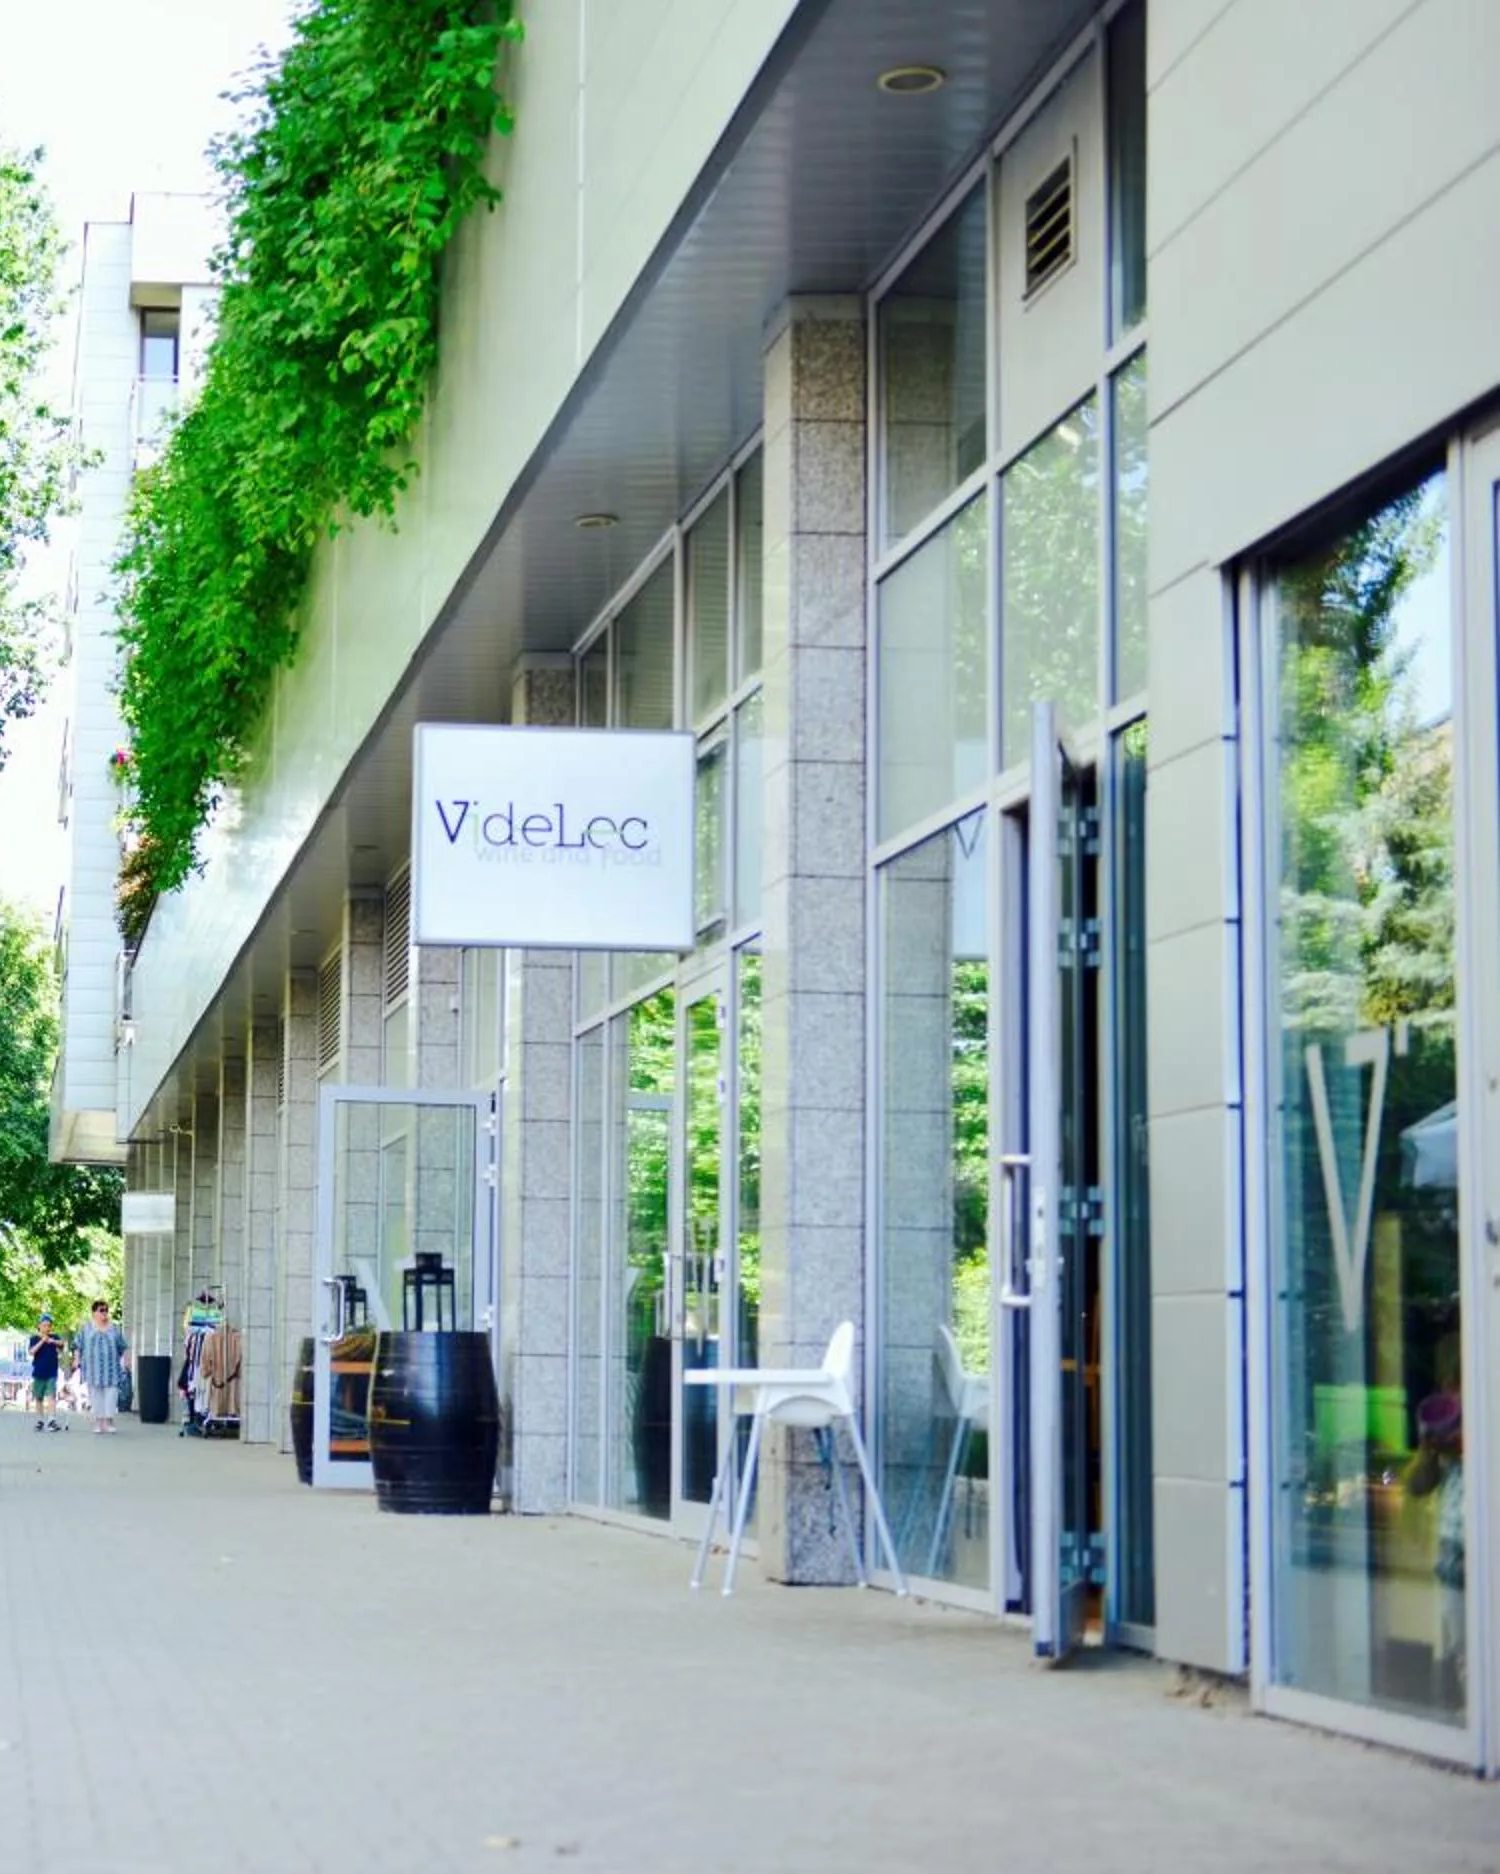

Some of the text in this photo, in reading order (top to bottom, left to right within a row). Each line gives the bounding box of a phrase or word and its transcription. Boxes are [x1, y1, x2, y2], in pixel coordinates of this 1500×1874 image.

[473, 843, 662, 872] wine and food
